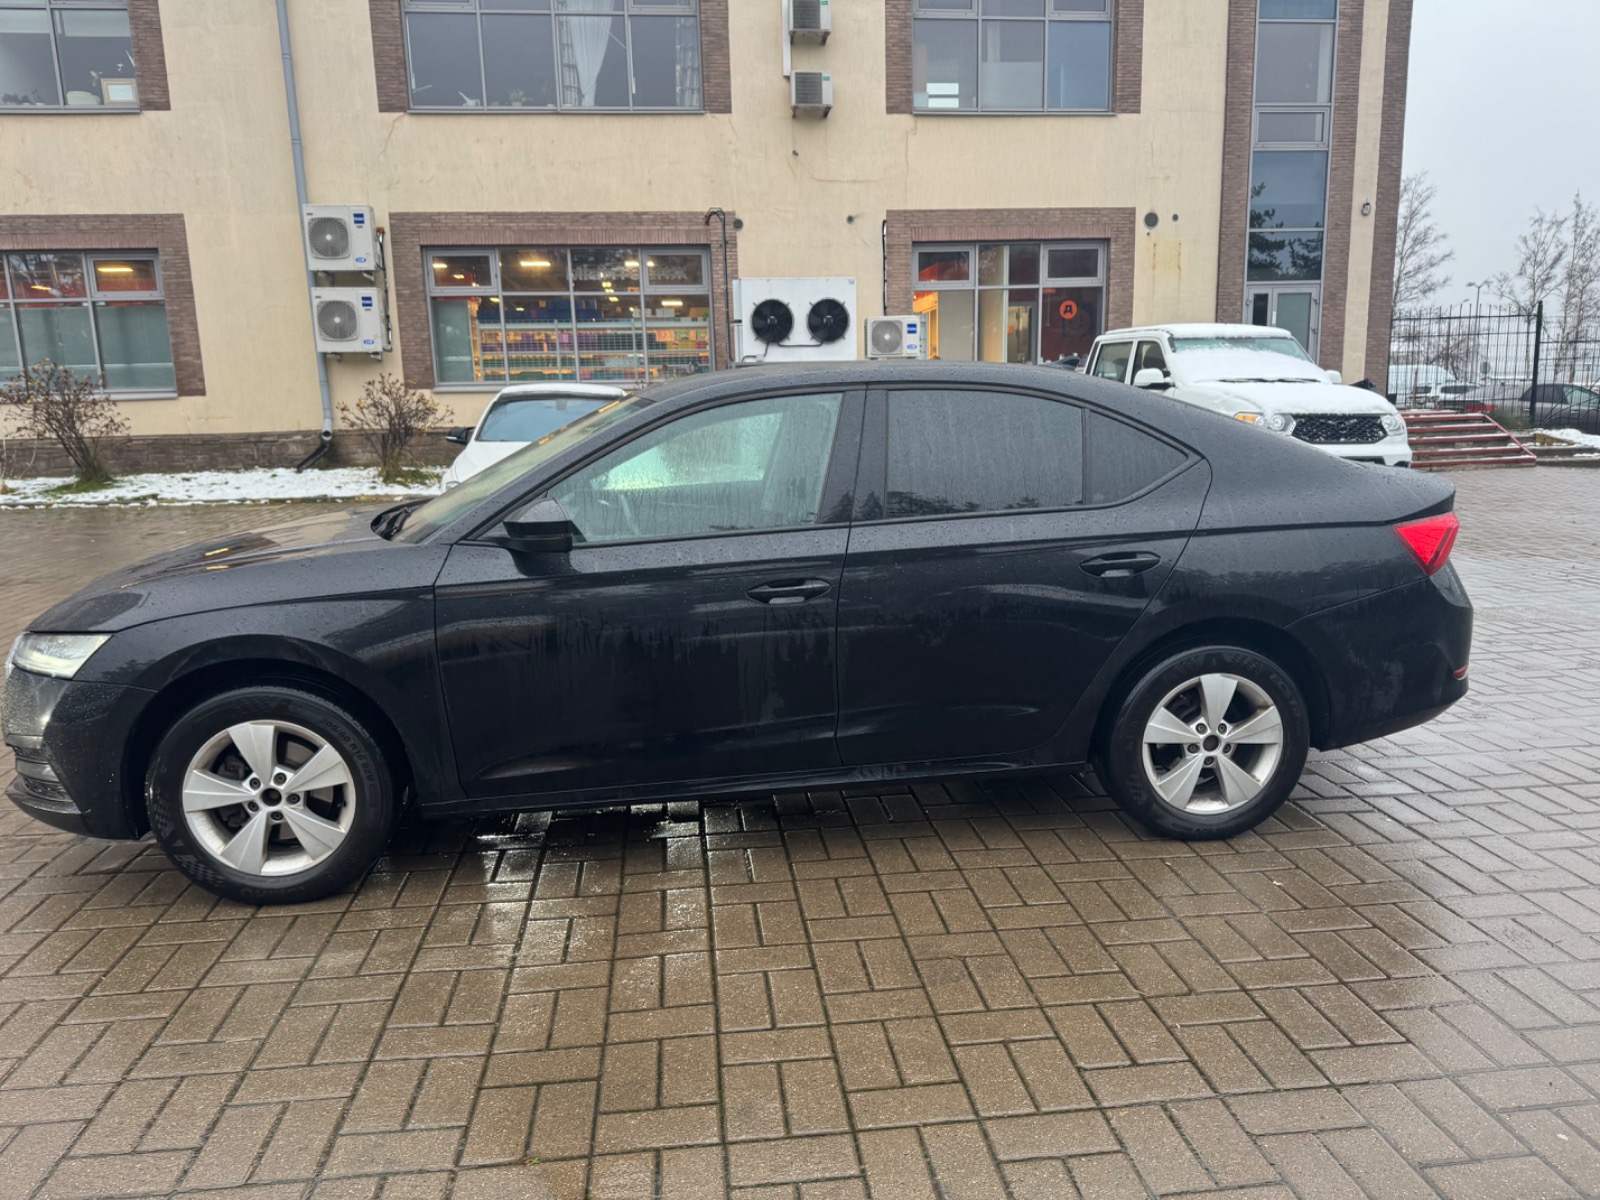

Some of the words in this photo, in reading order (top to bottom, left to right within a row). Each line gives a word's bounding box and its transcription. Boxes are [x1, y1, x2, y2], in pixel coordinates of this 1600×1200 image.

[320, 718, 351, 742] 205/60
[349, 743, 364, 760] R16
[361, 762, 375, 782] 92V
